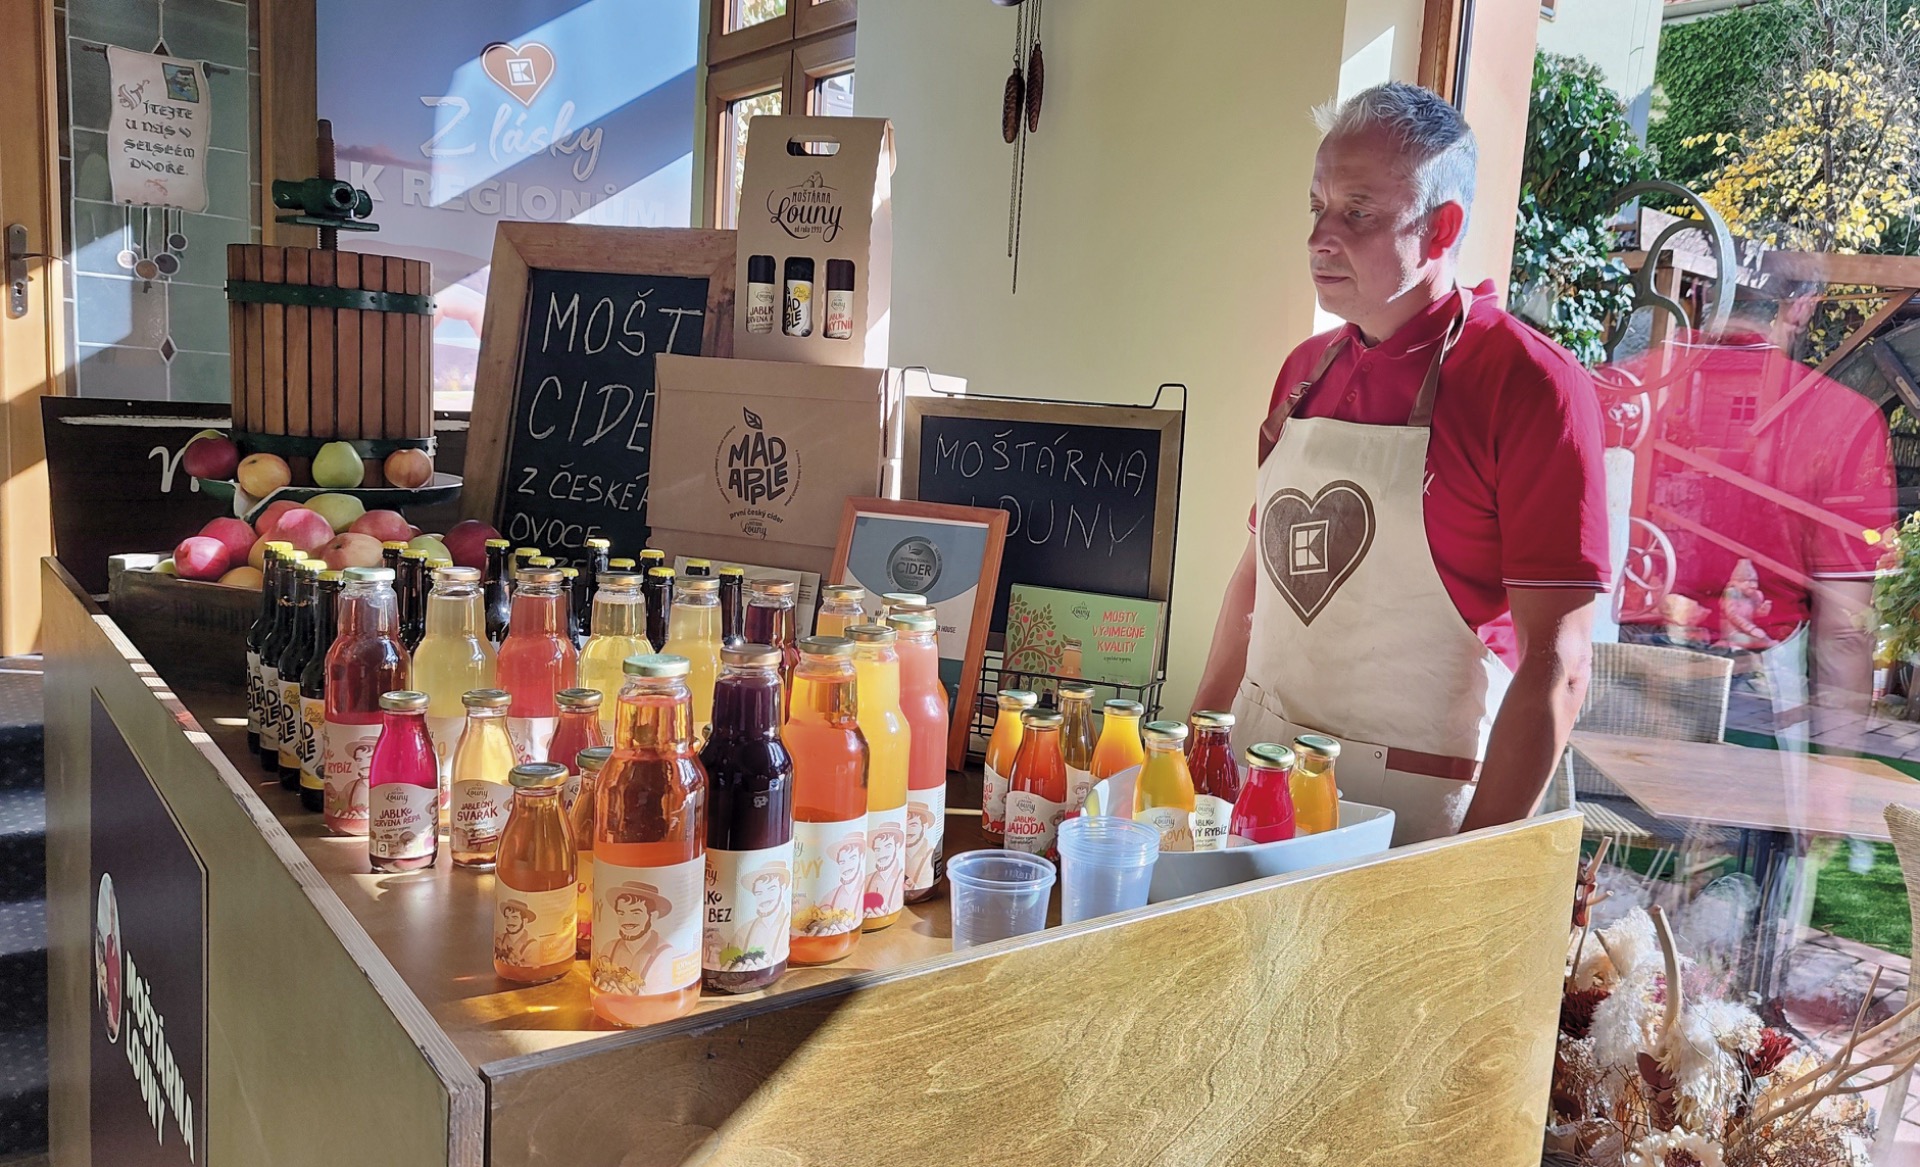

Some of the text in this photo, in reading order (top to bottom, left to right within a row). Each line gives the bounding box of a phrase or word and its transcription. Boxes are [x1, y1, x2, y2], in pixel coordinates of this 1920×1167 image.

[419, 96, 605, 182] Z lásky
[348, 161, 667, 226] K REGIONŮM
[791, 189, 831, 204] MOŠTÁRNA
[767, 190, 844, 243] Louny
[749, 305, 775, 315] JABLK
[787, 297, 801, 311] AD
[542, 288, 703, 356] MOŠT
[529, 376, 655, 453] CIDE
[728, 431, 787, 468] MAD
[935, 429, 1147, 497] MOŠTÁRNA
[517, 467, 538, 495] Z
[729, 508, 747, 520] první
[747, 508, 767, 519] český
[767, 512, 784, 524] cider
[510, 512, 602, 548] OVOCE
[972, 495, 1145, 557] OUNY
[896, 561, 932, 577] CIDER
[1097, 640, 1138, 653] KVALITY
[327, 761, 352, 774] RYBÍZ
[384, 790, 409, 805] Louny
[465, 788, 489, 800] Louny
[379, 807, 413, 820] JABLKO
[1007, 822, 1046, 835] JAHODA
[1204, 824, 1228, 838] RYBÍZ
[708, 907, 732, 923] BEZ
[126, 950, 195, 1166] MOŠTÁRNA
[126, 1009, 166, 1147] LOUNY
